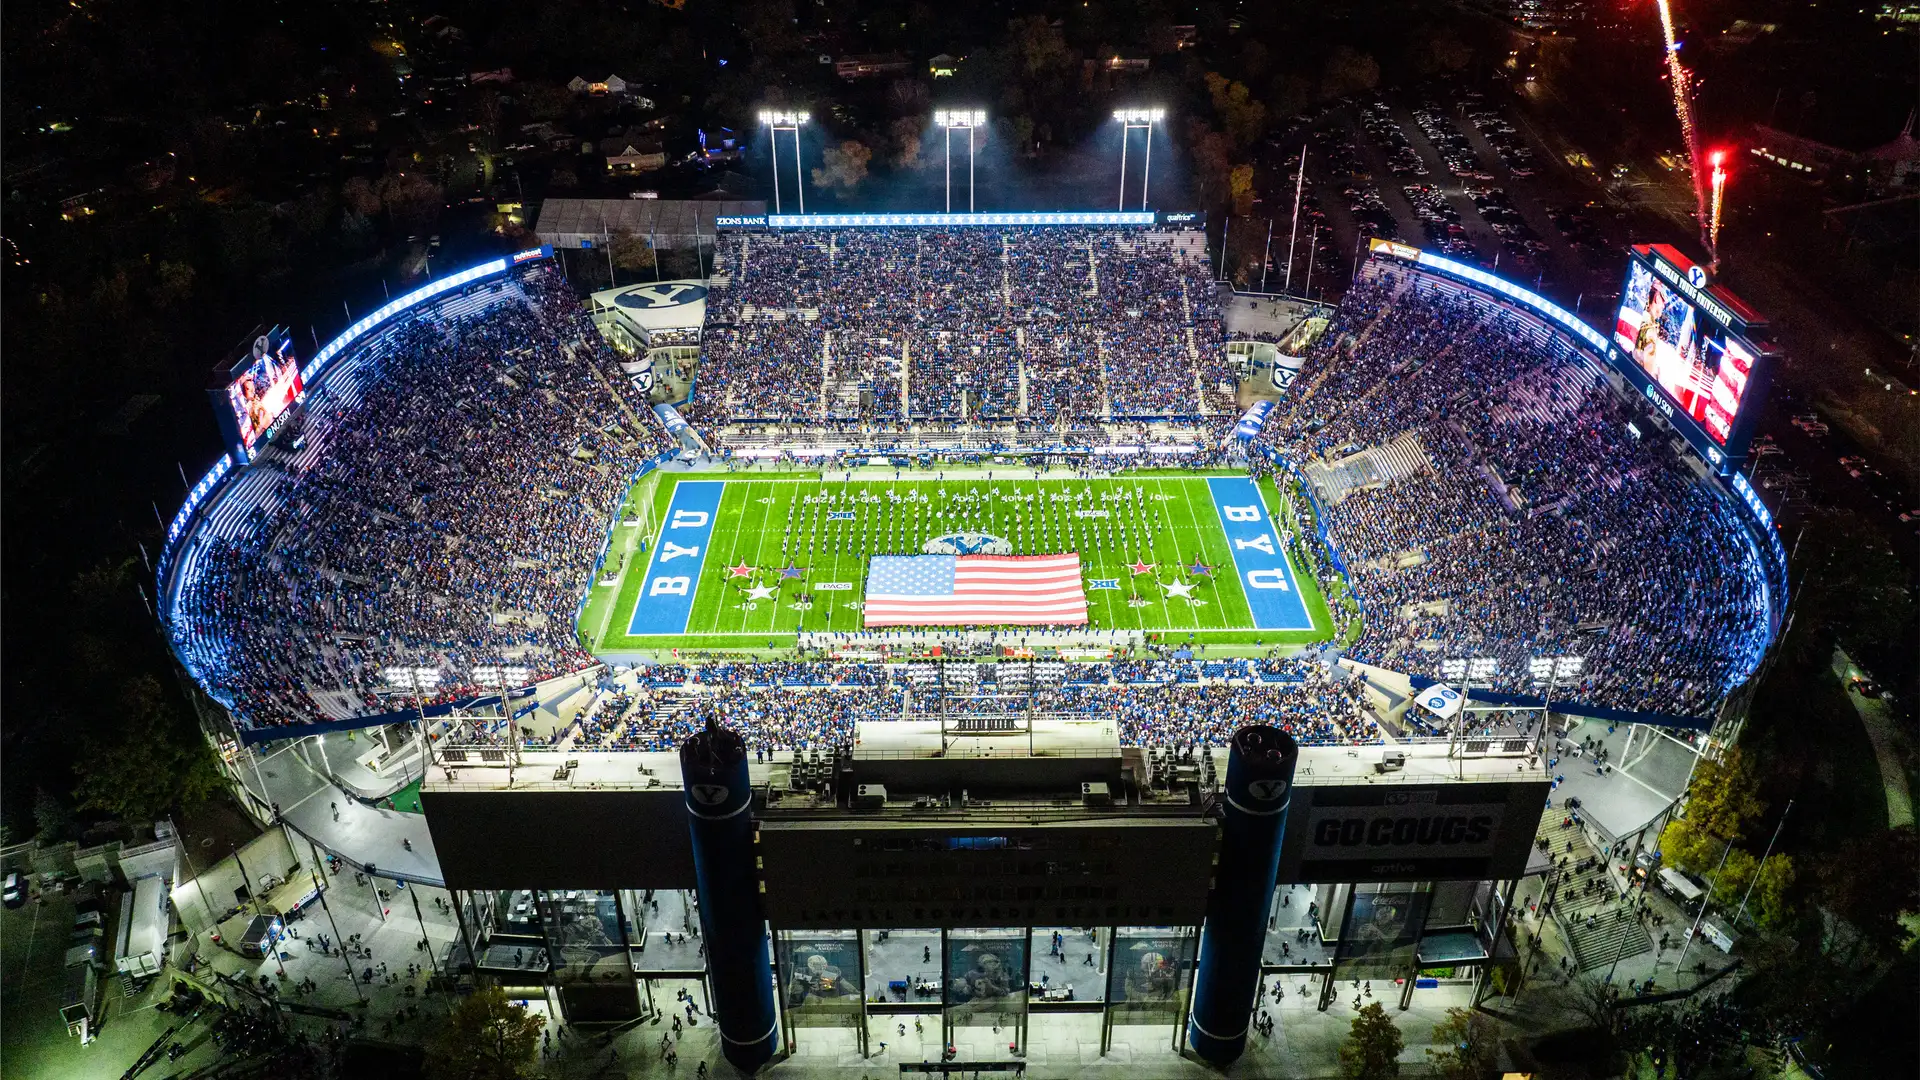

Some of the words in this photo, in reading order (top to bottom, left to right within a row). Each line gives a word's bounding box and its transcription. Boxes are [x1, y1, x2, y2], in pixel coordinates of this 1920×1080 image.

[743, 217, 766, 225] BANK
[1167, 213, 1191, 223] qualtrics
[513, 248, 542, 261] nutricost
[1692, 268, 1703, 286] Y
[625, 284, 696, 308] Y
[1696, 291, 1733, 327] UNIVERSITY
[631, 373, 649, 391] Y
[1277, 370, 1294, 385] Y
[1652, 391, 1662, 405] NU
[1661, 401, 1674, 418] SKIN
[271, 419, 281, 434] NU
[279, 407, 291, 426] SKIN
[649, 509, 709, 597] BYU
[1223, 505, 1290, 592] BYU
[1093, 580, 1115, 588] XII
[741, 602, 757, 611] 10
[794, 602, 813, 610] 20
[1185, 599, 1202, 607] 10
[695, 786, 721, 803] Y
[1257, 781, 1282, 798] Y
[1314, 819, 1364, 847] GO
[1366, 816, 1493, 846] COUGS
[1371, 863, 1416, 875] aptive
